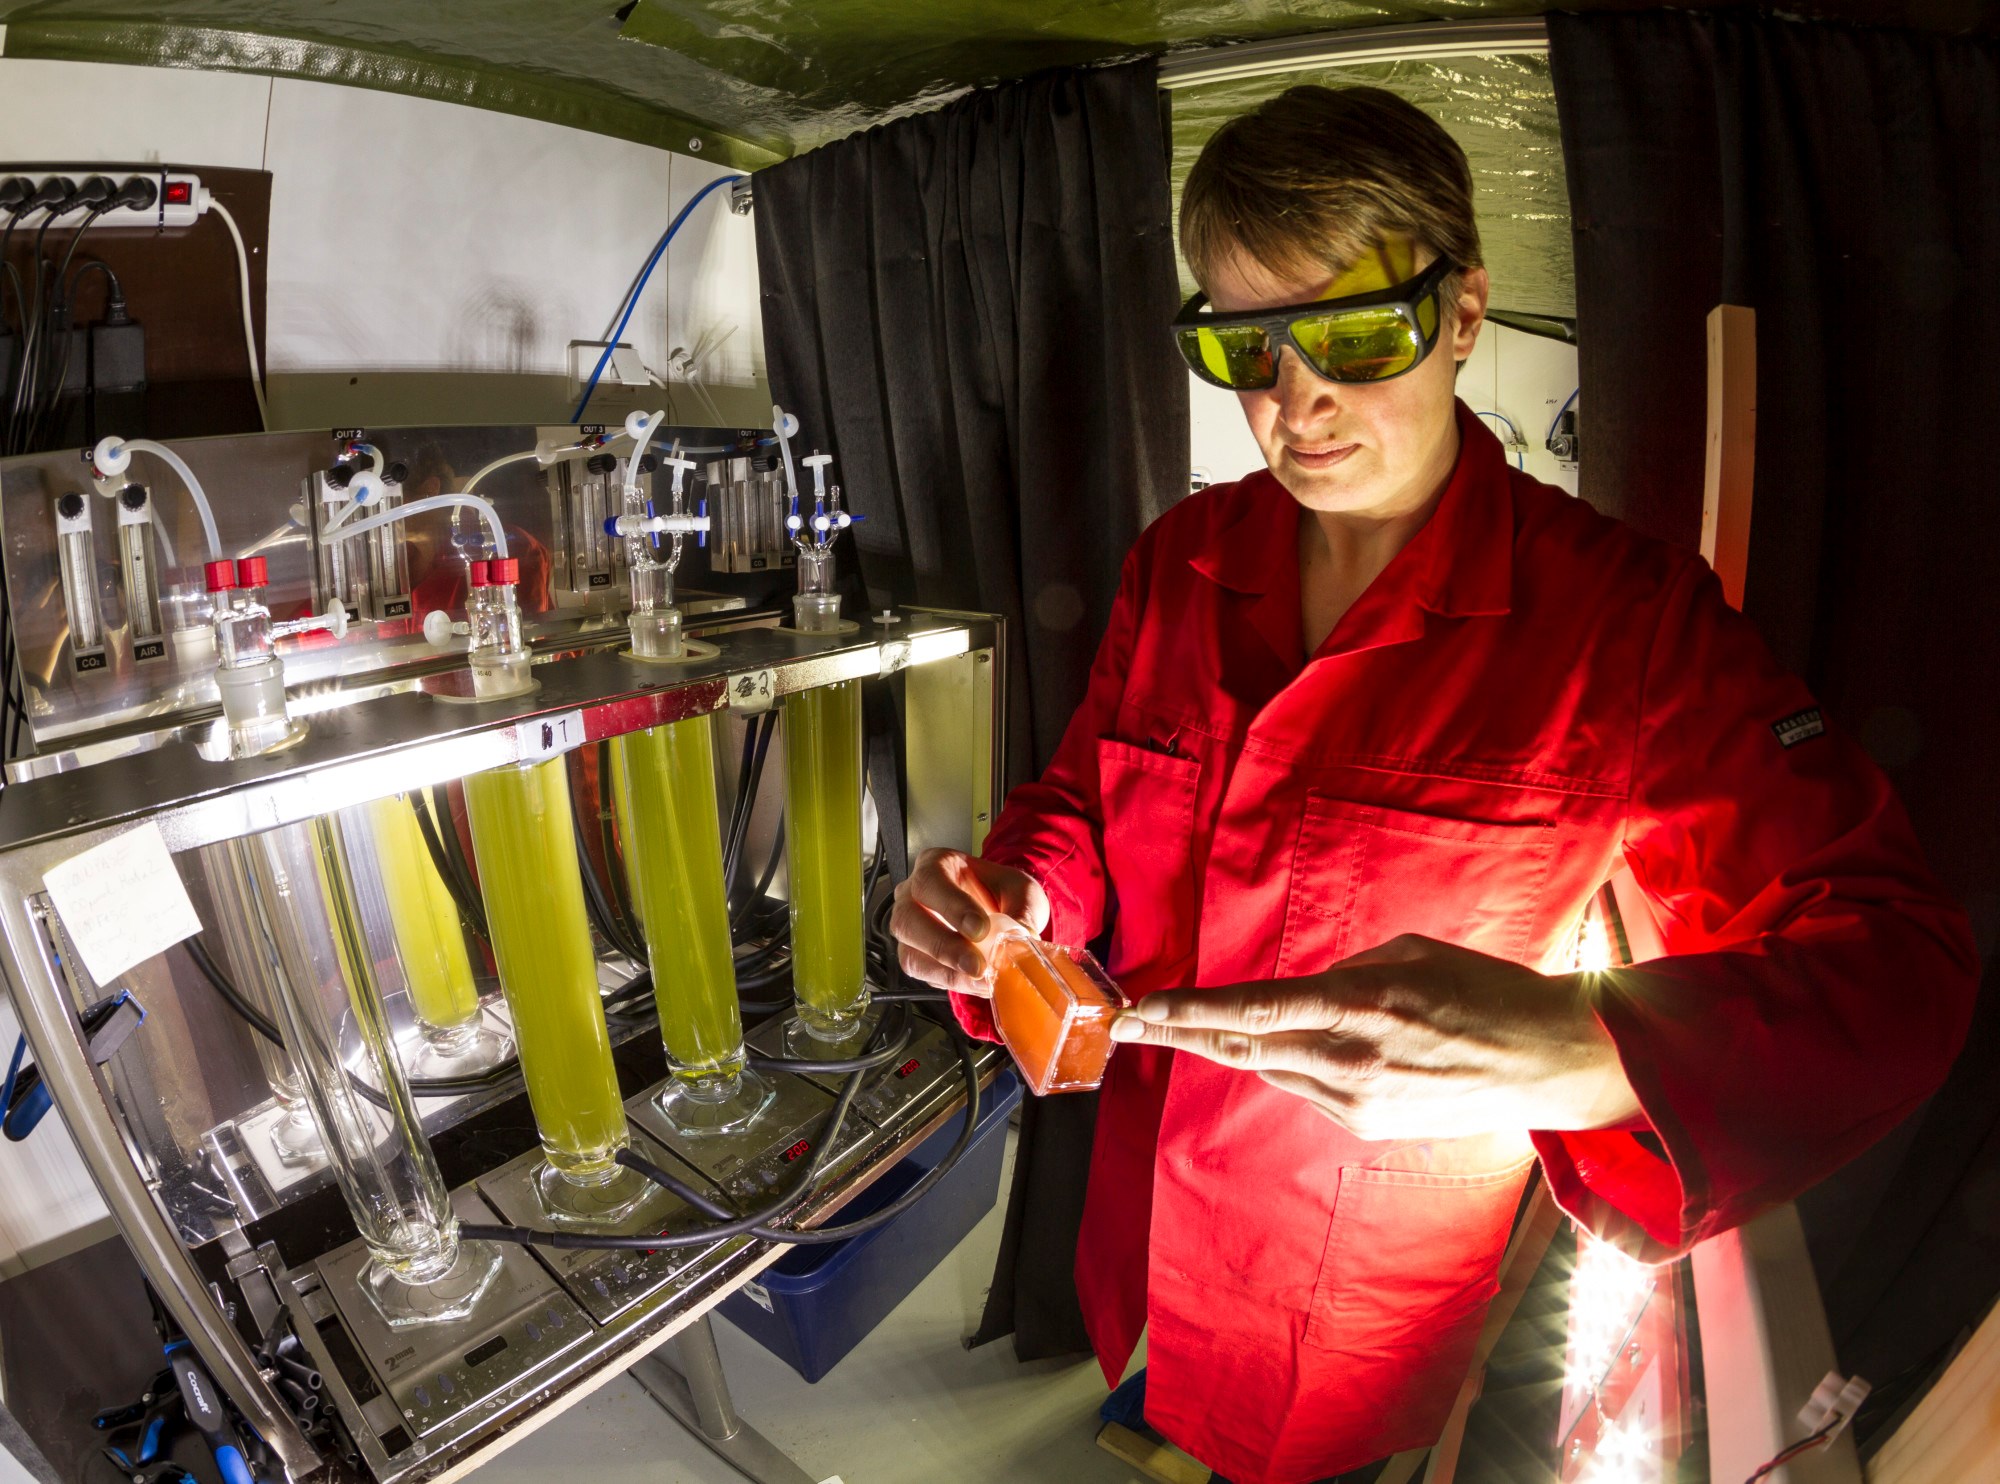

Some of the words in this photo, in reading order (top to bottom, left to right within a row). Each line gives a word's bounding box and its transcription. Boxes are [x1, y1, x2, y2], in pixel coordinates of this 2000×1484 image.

[336, 430, 355, 439] OUT
[356, 430, 362, 438] 2
[390, 604, 405, 614] AIR
[140, 646, 158, 657] AIR
[758, 670, 770, 698] 2
[899, 1059, 919, 1077] 200
[786, 1140, 809, 1160] 200
